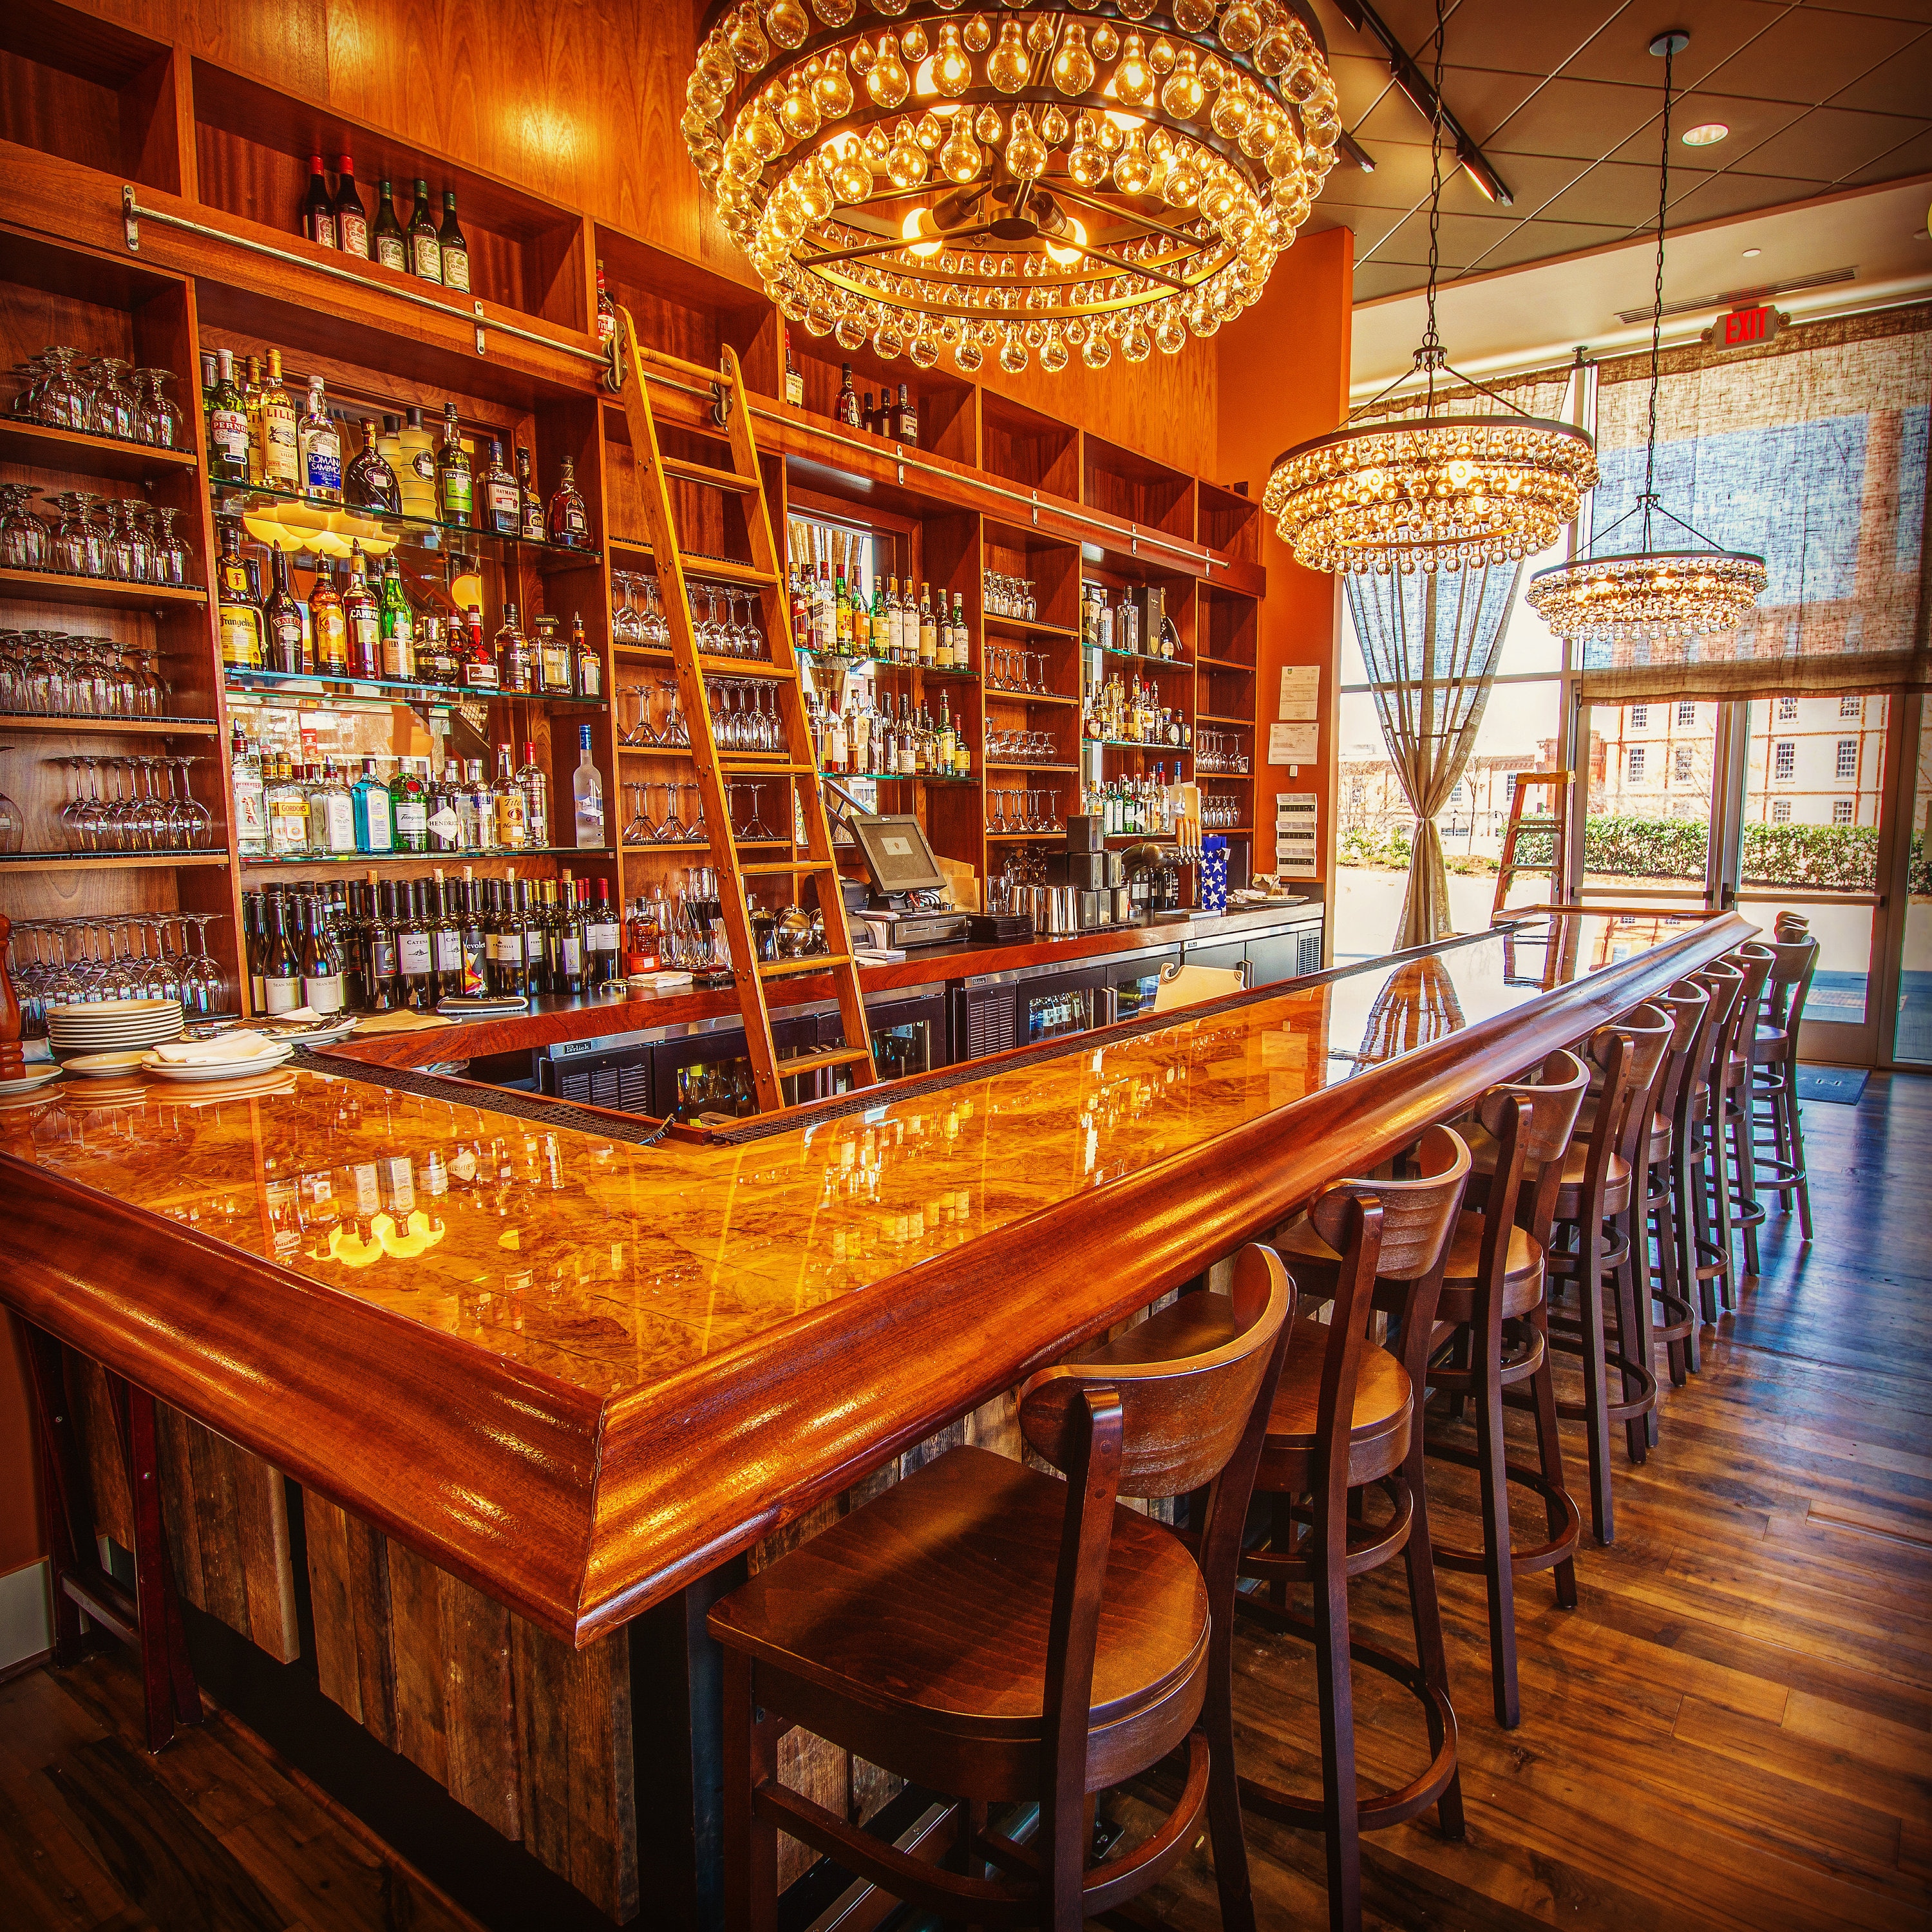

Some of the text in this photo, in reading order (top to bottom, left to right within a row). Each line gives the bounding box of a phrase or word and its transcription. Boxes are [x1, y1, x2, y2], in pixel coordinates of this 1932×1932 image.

[1725, 307, 1769, 345] EXIT
[266, 408, 296, 422] LILLE
[220, 614, 255, 628] Frangelico
[565, 1043, 590, 1053] Perlick
